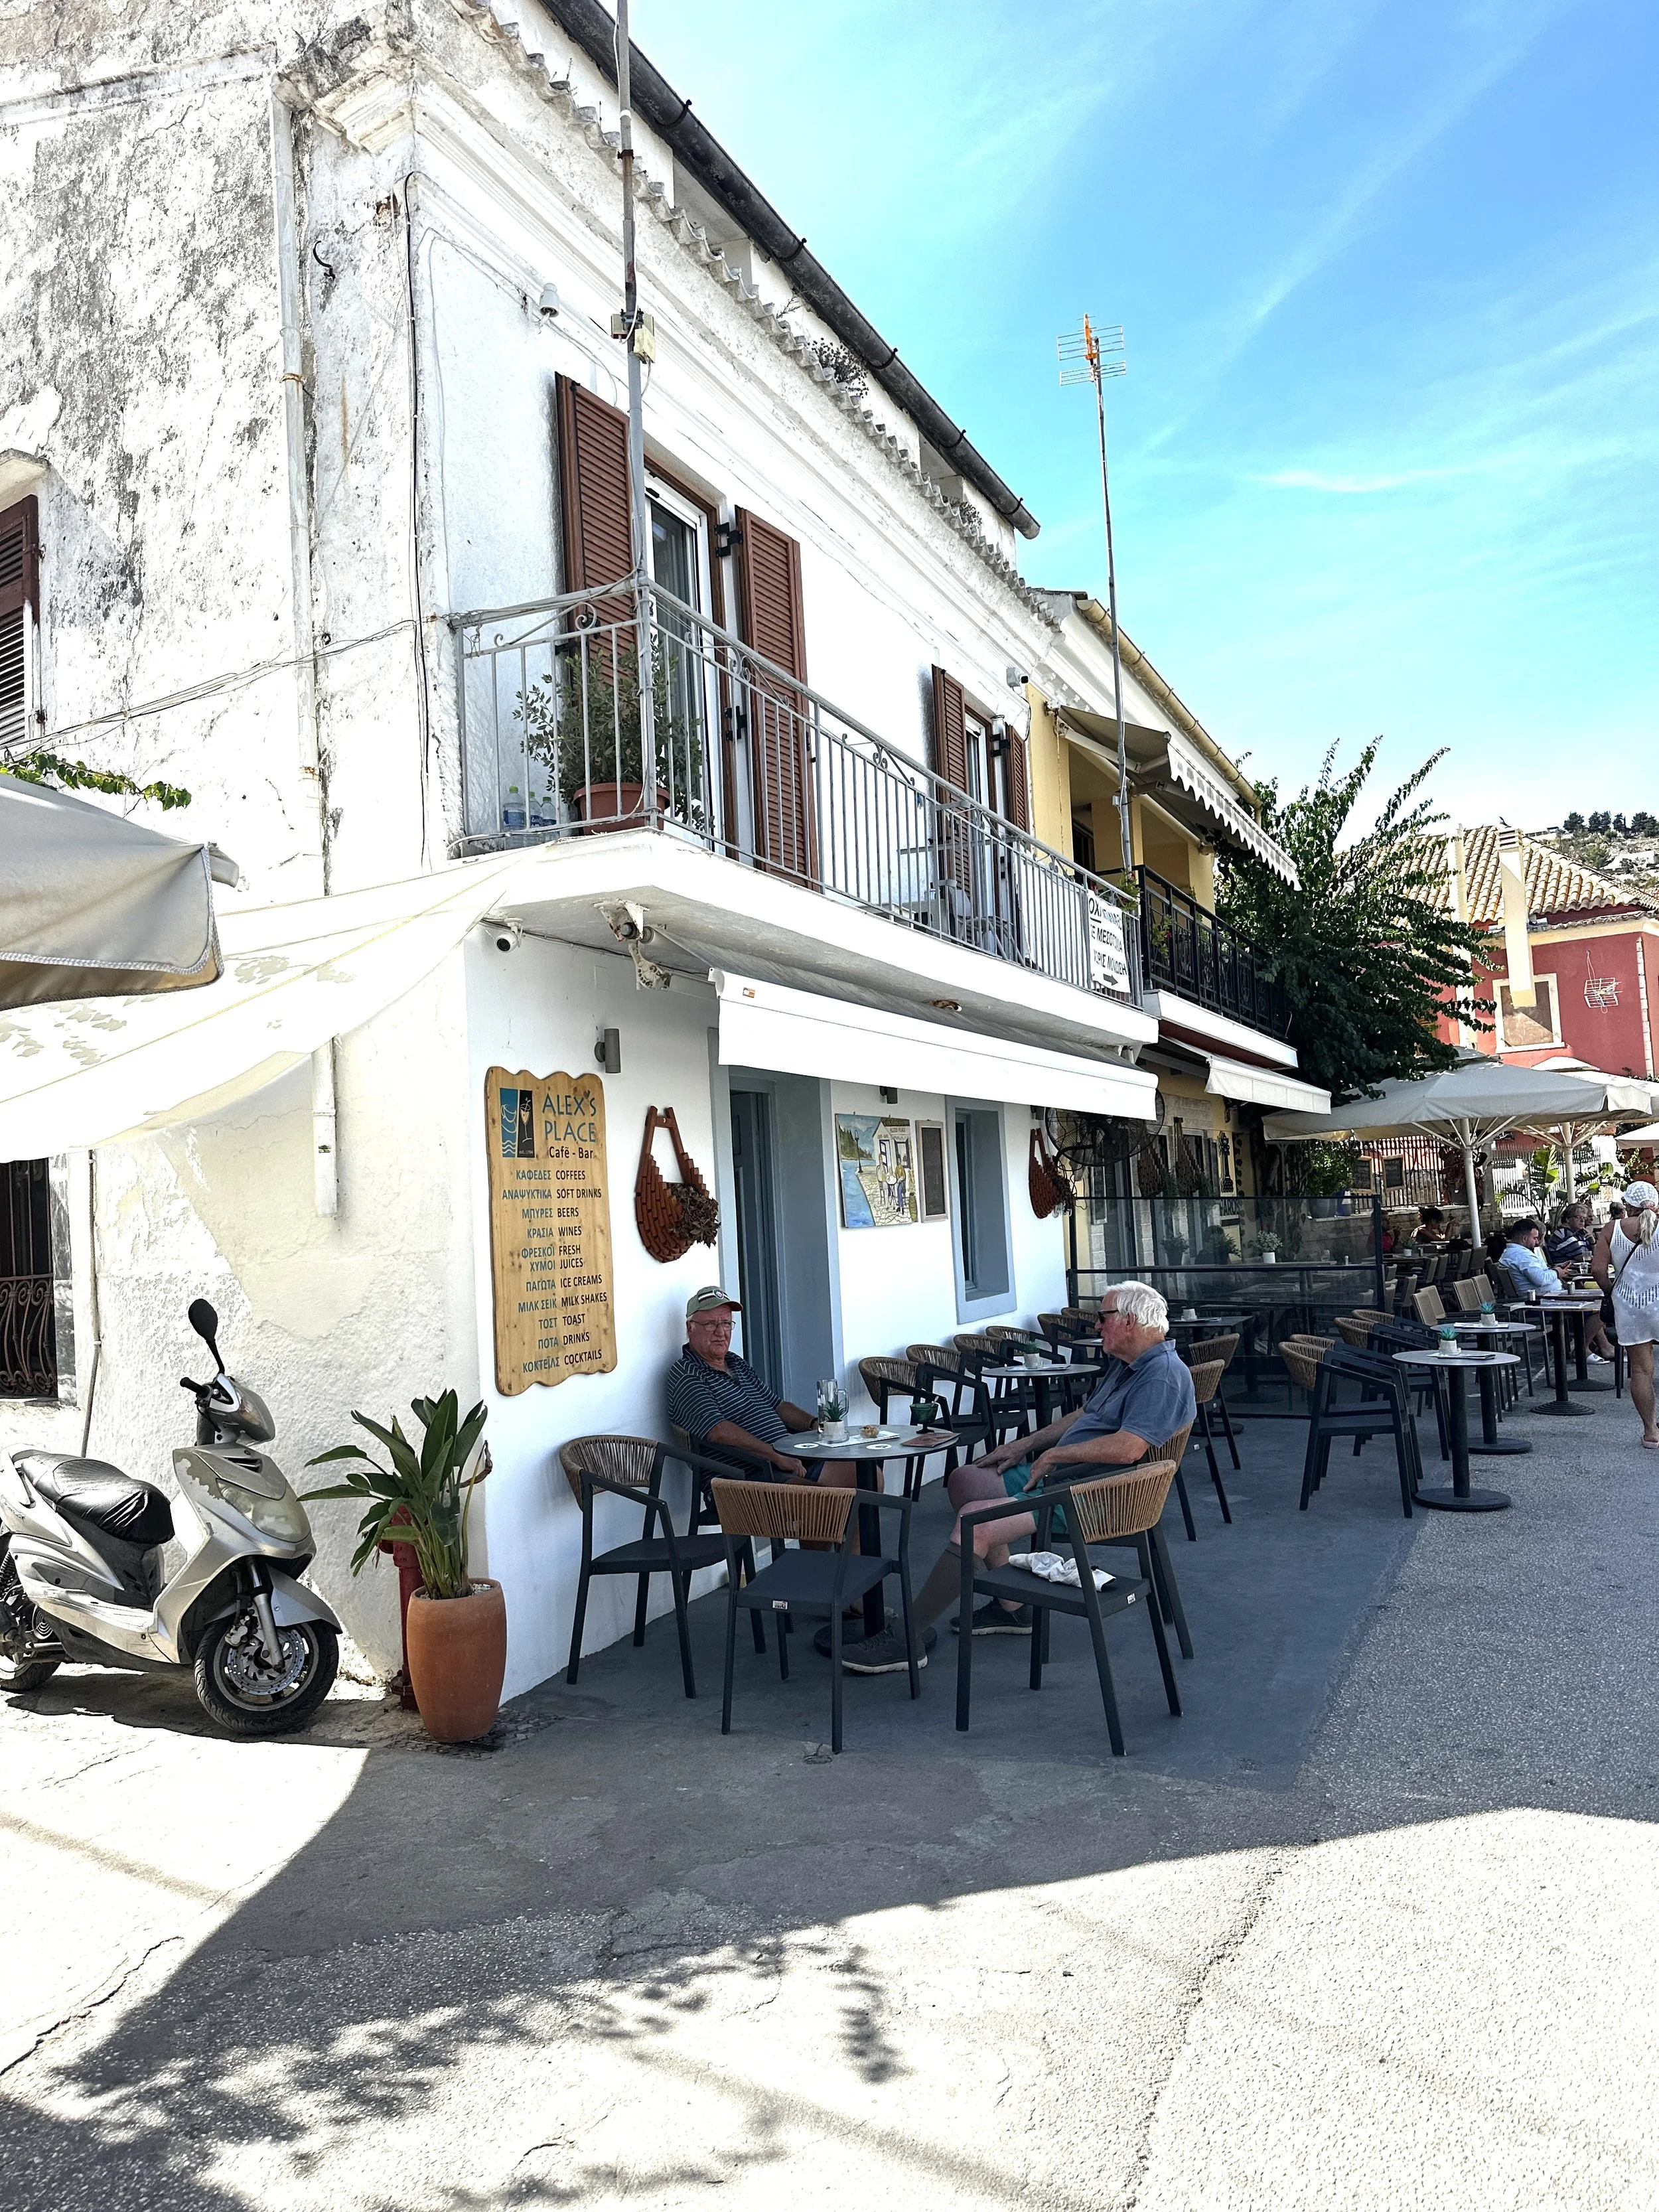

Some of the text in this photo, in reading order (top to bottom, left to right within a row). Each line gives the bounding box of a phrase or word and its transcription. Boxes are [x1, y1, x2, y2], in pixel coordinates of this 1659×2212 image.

[541, 1090, 597, 1117] ALEX'S
[545, 1120, 596, 1143] PLACE
[578, 1147, 593, 1159] Bar
[516, 1169, 551, 1181] ΚΑΦΕΔΕΣ
[555, 1170, 586, 1180] COFFEES
[502, 1189, 552, 1200] ΑΝΑΨΥΚΤΙΚΑ
[556, 1188, 602, 1199] SOFT DRINKS
[522, 1207, 553, 1219] ΜΠΥΡΕΣ
[557, 1207, 579, 1218] BEERS
[527, 1227, 554, 1239] ΚΡΑΣΙΑ
[558, 1226, 582, 1237] WINES
[522, 1246, 555, 1259] ΦΡΕΣΚΟΙ
[559, 1244, 581, 1256] FRESH
[530, 1260, 555, 1272] ΧΥΜΟΙ
[559, 1258, 583, 1269] JUICES
[526, 1280, 556, 1292] ΠΑΓΩΤΑ
[560, 1274, 603, 1288] ICE CREAMS
[561, 1291, 607, 1307] MILK SHAKES
[518, 1298, 557, 1313] ΜΙΛΚ ΣΕΙΚ
[538, 1317, 557, 1329] ΤΟΣΤ
[562, 1313, 585, 1326] TOAST
[538, 1337, 559, 1350] ΠΟΤΑ
[563, 1331, 590, 1346] DRINKS
[564, 1349, 602, 1366] COCKTAILS
